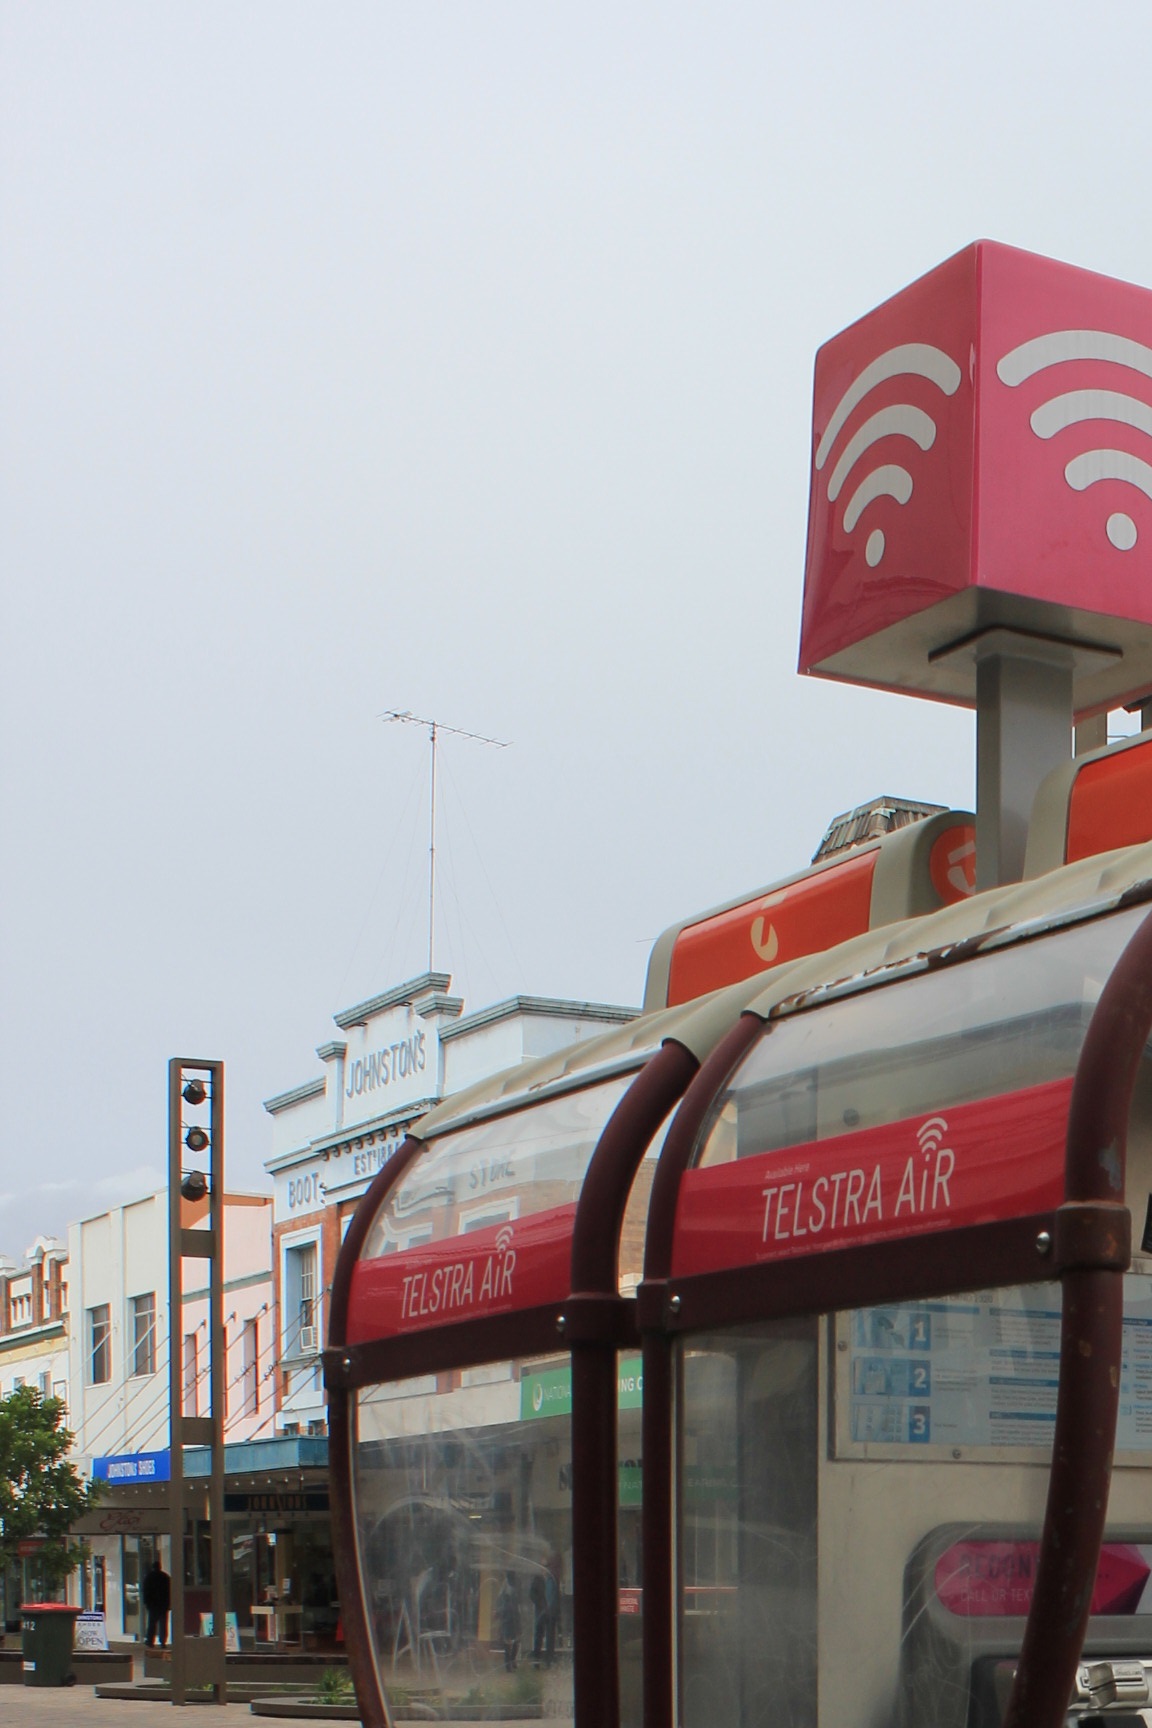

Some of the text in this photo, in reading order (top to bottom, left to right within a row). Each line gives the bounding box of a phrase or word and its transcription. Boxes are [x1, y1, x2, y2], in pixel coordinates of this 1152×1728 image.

[346, 1029, 426, 1099] JOHNSTON'S
[762, 1163, 883, 1243] TELSTRA
[401, 1260, 475, 1319] TELSTRA
[914, 1321, 927, 1342] 1
[913, 1367, 927, 1389] 2
[912, 1414, 927, 1435] 3
[138, 1459, 156, 1475] SHOES
[77, 1636, 104, 1646] OPEN
